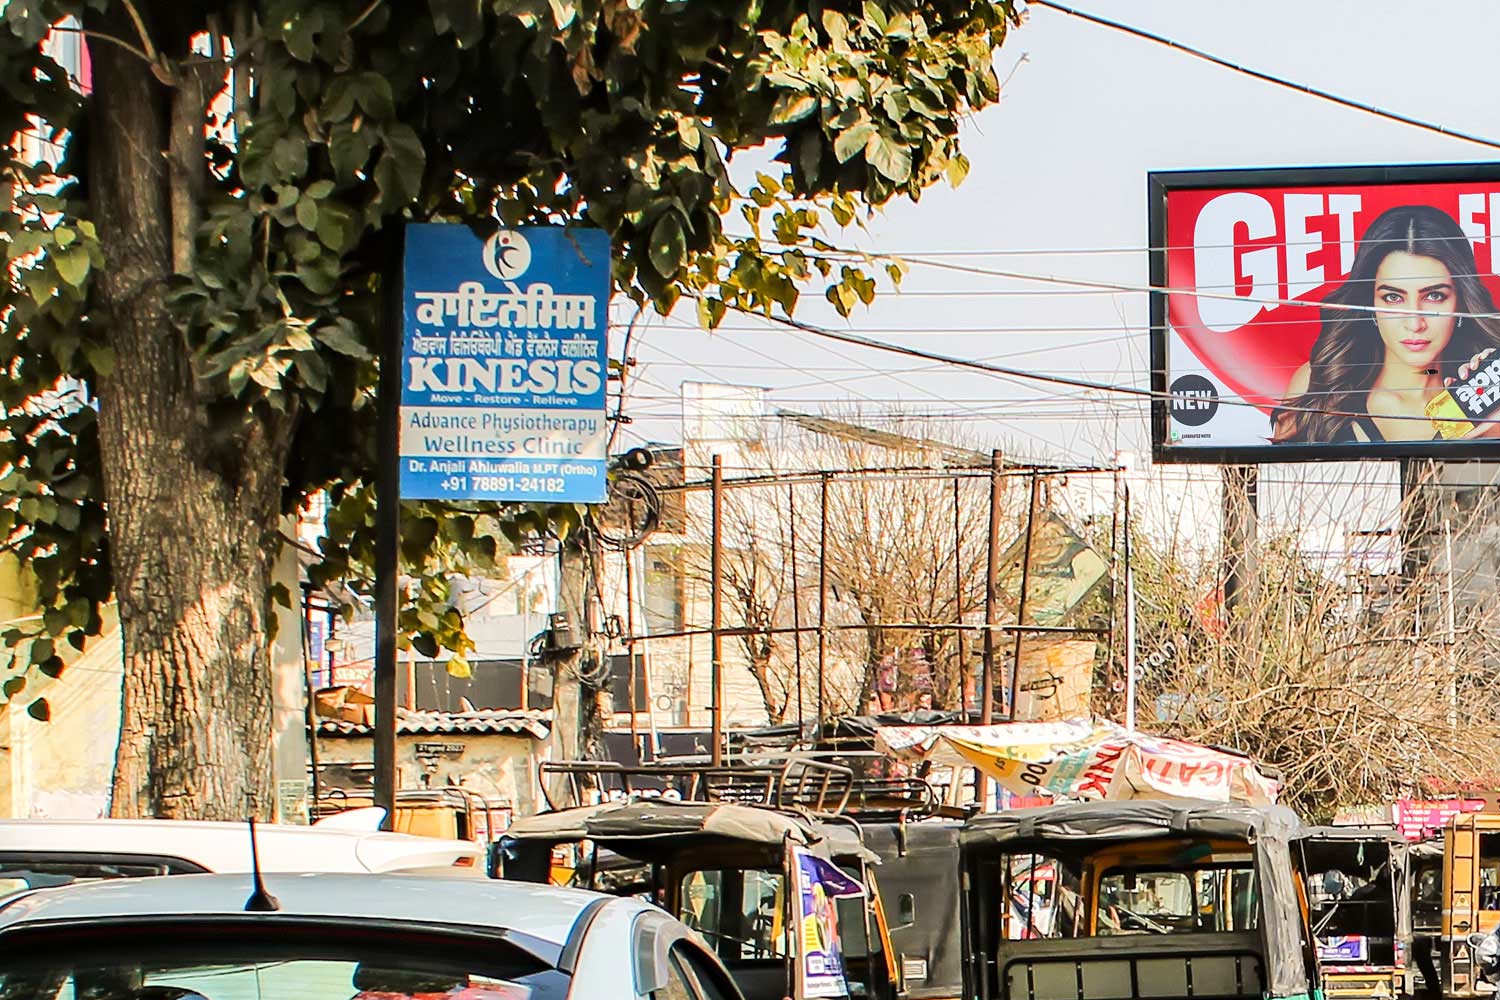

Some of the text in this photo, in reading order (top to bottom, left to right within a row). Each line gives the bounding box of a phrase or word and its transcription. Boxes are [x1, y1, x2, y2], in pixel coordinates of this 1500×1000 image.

[1193, 191, 1362, 333] GET
[408, 358, 601, 395] KINESIS
[431, 394, 462, 404] Move
[475, 394, 521, 404] Restore
[533, 395, 578, 405] Relieve
[1172, 390, 1212, 410] NEW
[410, 411, 597, 435] Advance Physiotherapy
[424, 435, 584, 455] Wellness Clinic
[409, 460, 427, 473] Dr.
[430, 459, 466, 476] Anjali
[441, 477, 565, 493] +91 78891-24182
